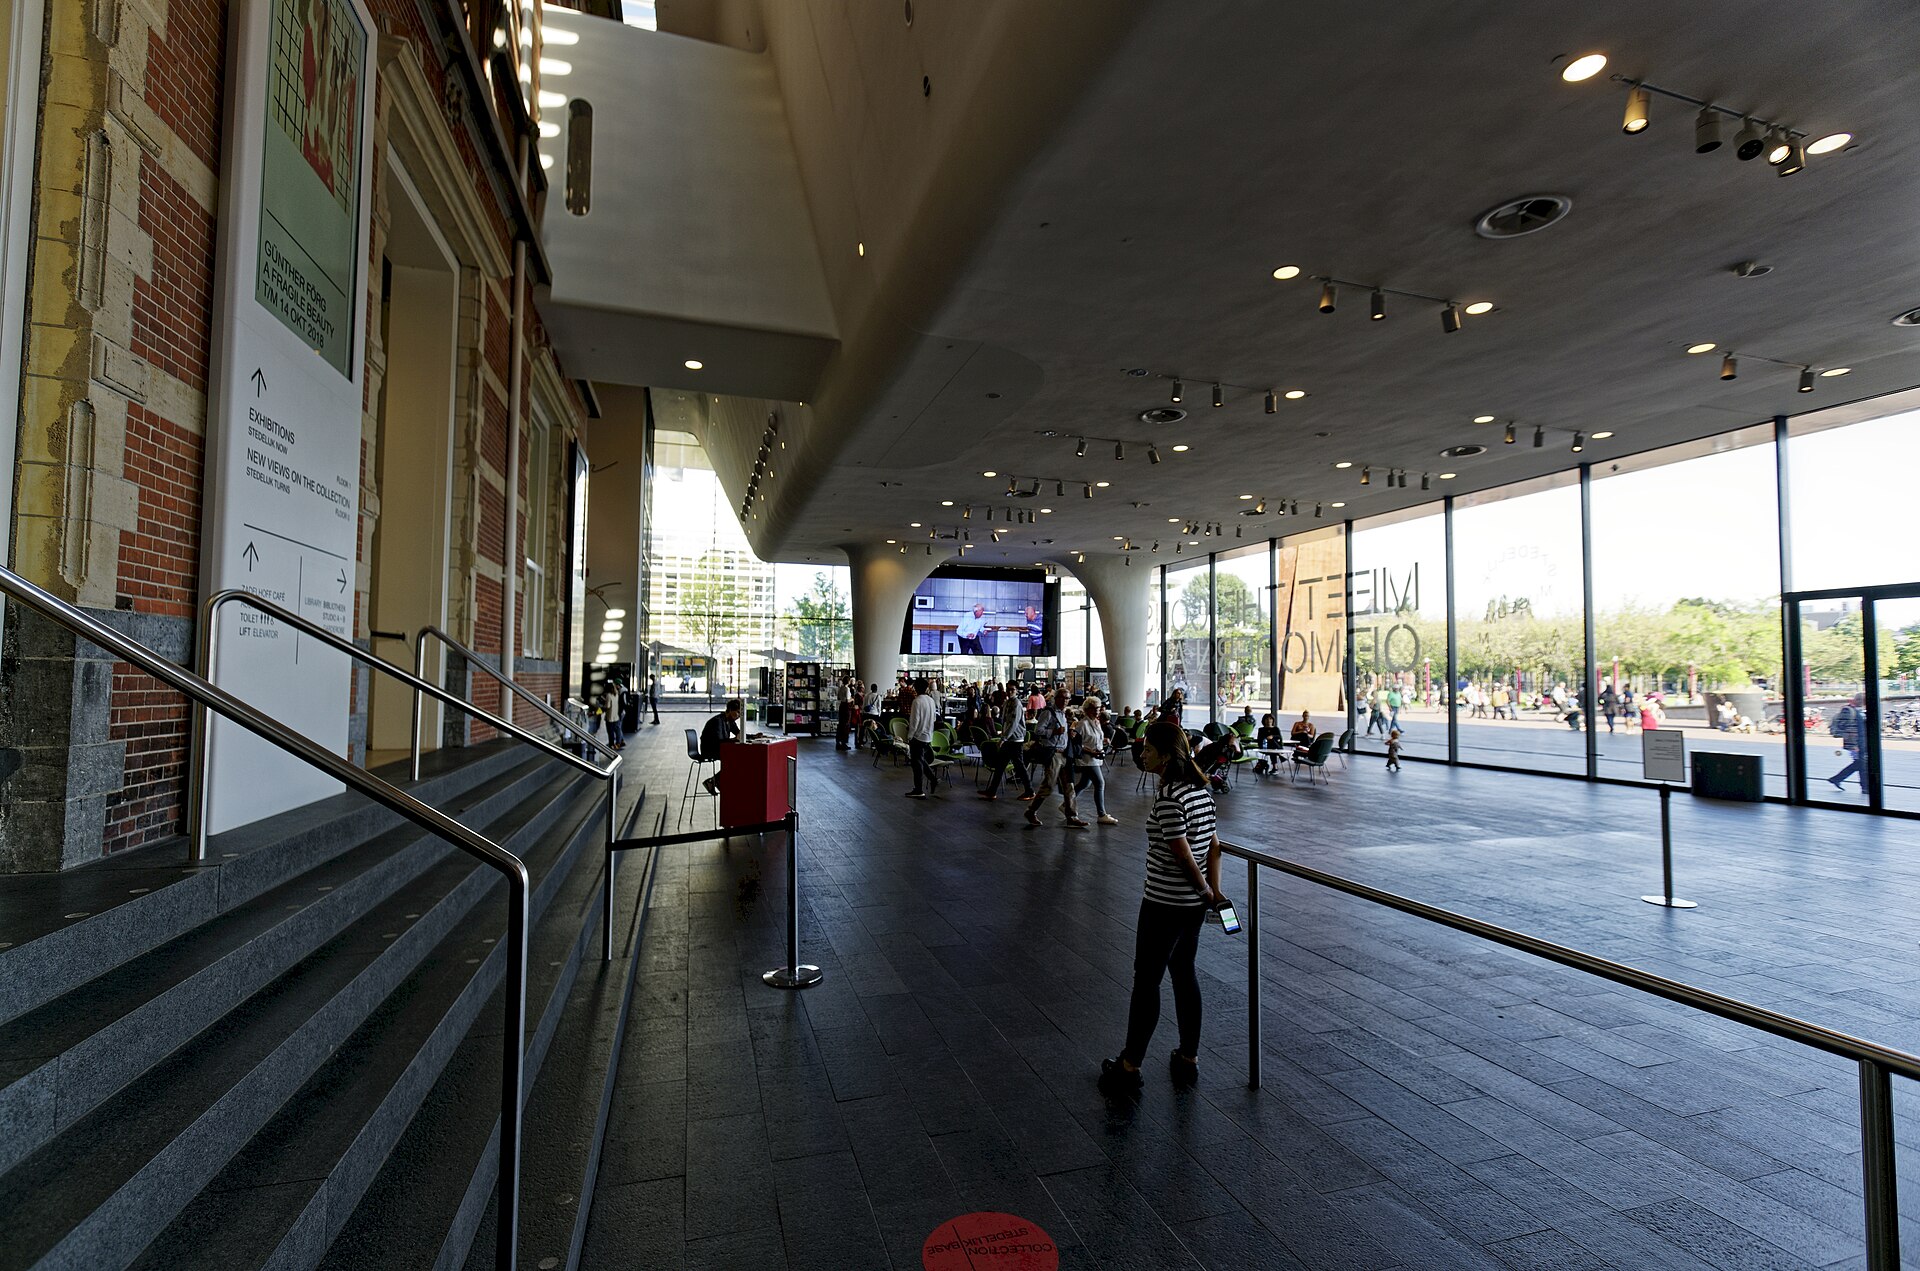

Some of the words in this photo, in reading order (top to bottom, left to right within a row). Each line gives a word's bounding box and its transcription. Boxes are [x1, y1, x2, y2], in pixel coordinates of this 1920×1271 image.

[264, 239, 306, 292] GÜNTHER
[306, 282, 327, 313] FÖRG
[263, 261, 270, 279] A
[271, 267, 306, 313] FRAGILE
[306, 302, 335, 339] BEAUTY
[262, 279, 278, 308] T/M
[280, 298, 289, 317] 14
[290, 307, 307, 332] OKT
[307, 323, 324, 348] 2018
[249, 406, 295, 445] EXHIBITIONS
[275, 440, 289, 455] NOW
[247, 447, 267, 468] NEW
[267, 457, 291, 480] VIEWS
[291, 470, 302, 486] ON
[302, 475, 316, 493] THE
[315, 482, 351, 510] COLLECTION
[273, 479, 291, 495] TURNS
[240, 612, 259, 625] TOILET
[239, 626, 251, 637] LIFT
[252, 627, 280, 640] ELEVATOR
[927, 1240, 961, 1255] BASE
[968, 1242, 1053, 1256] COLLECTION
